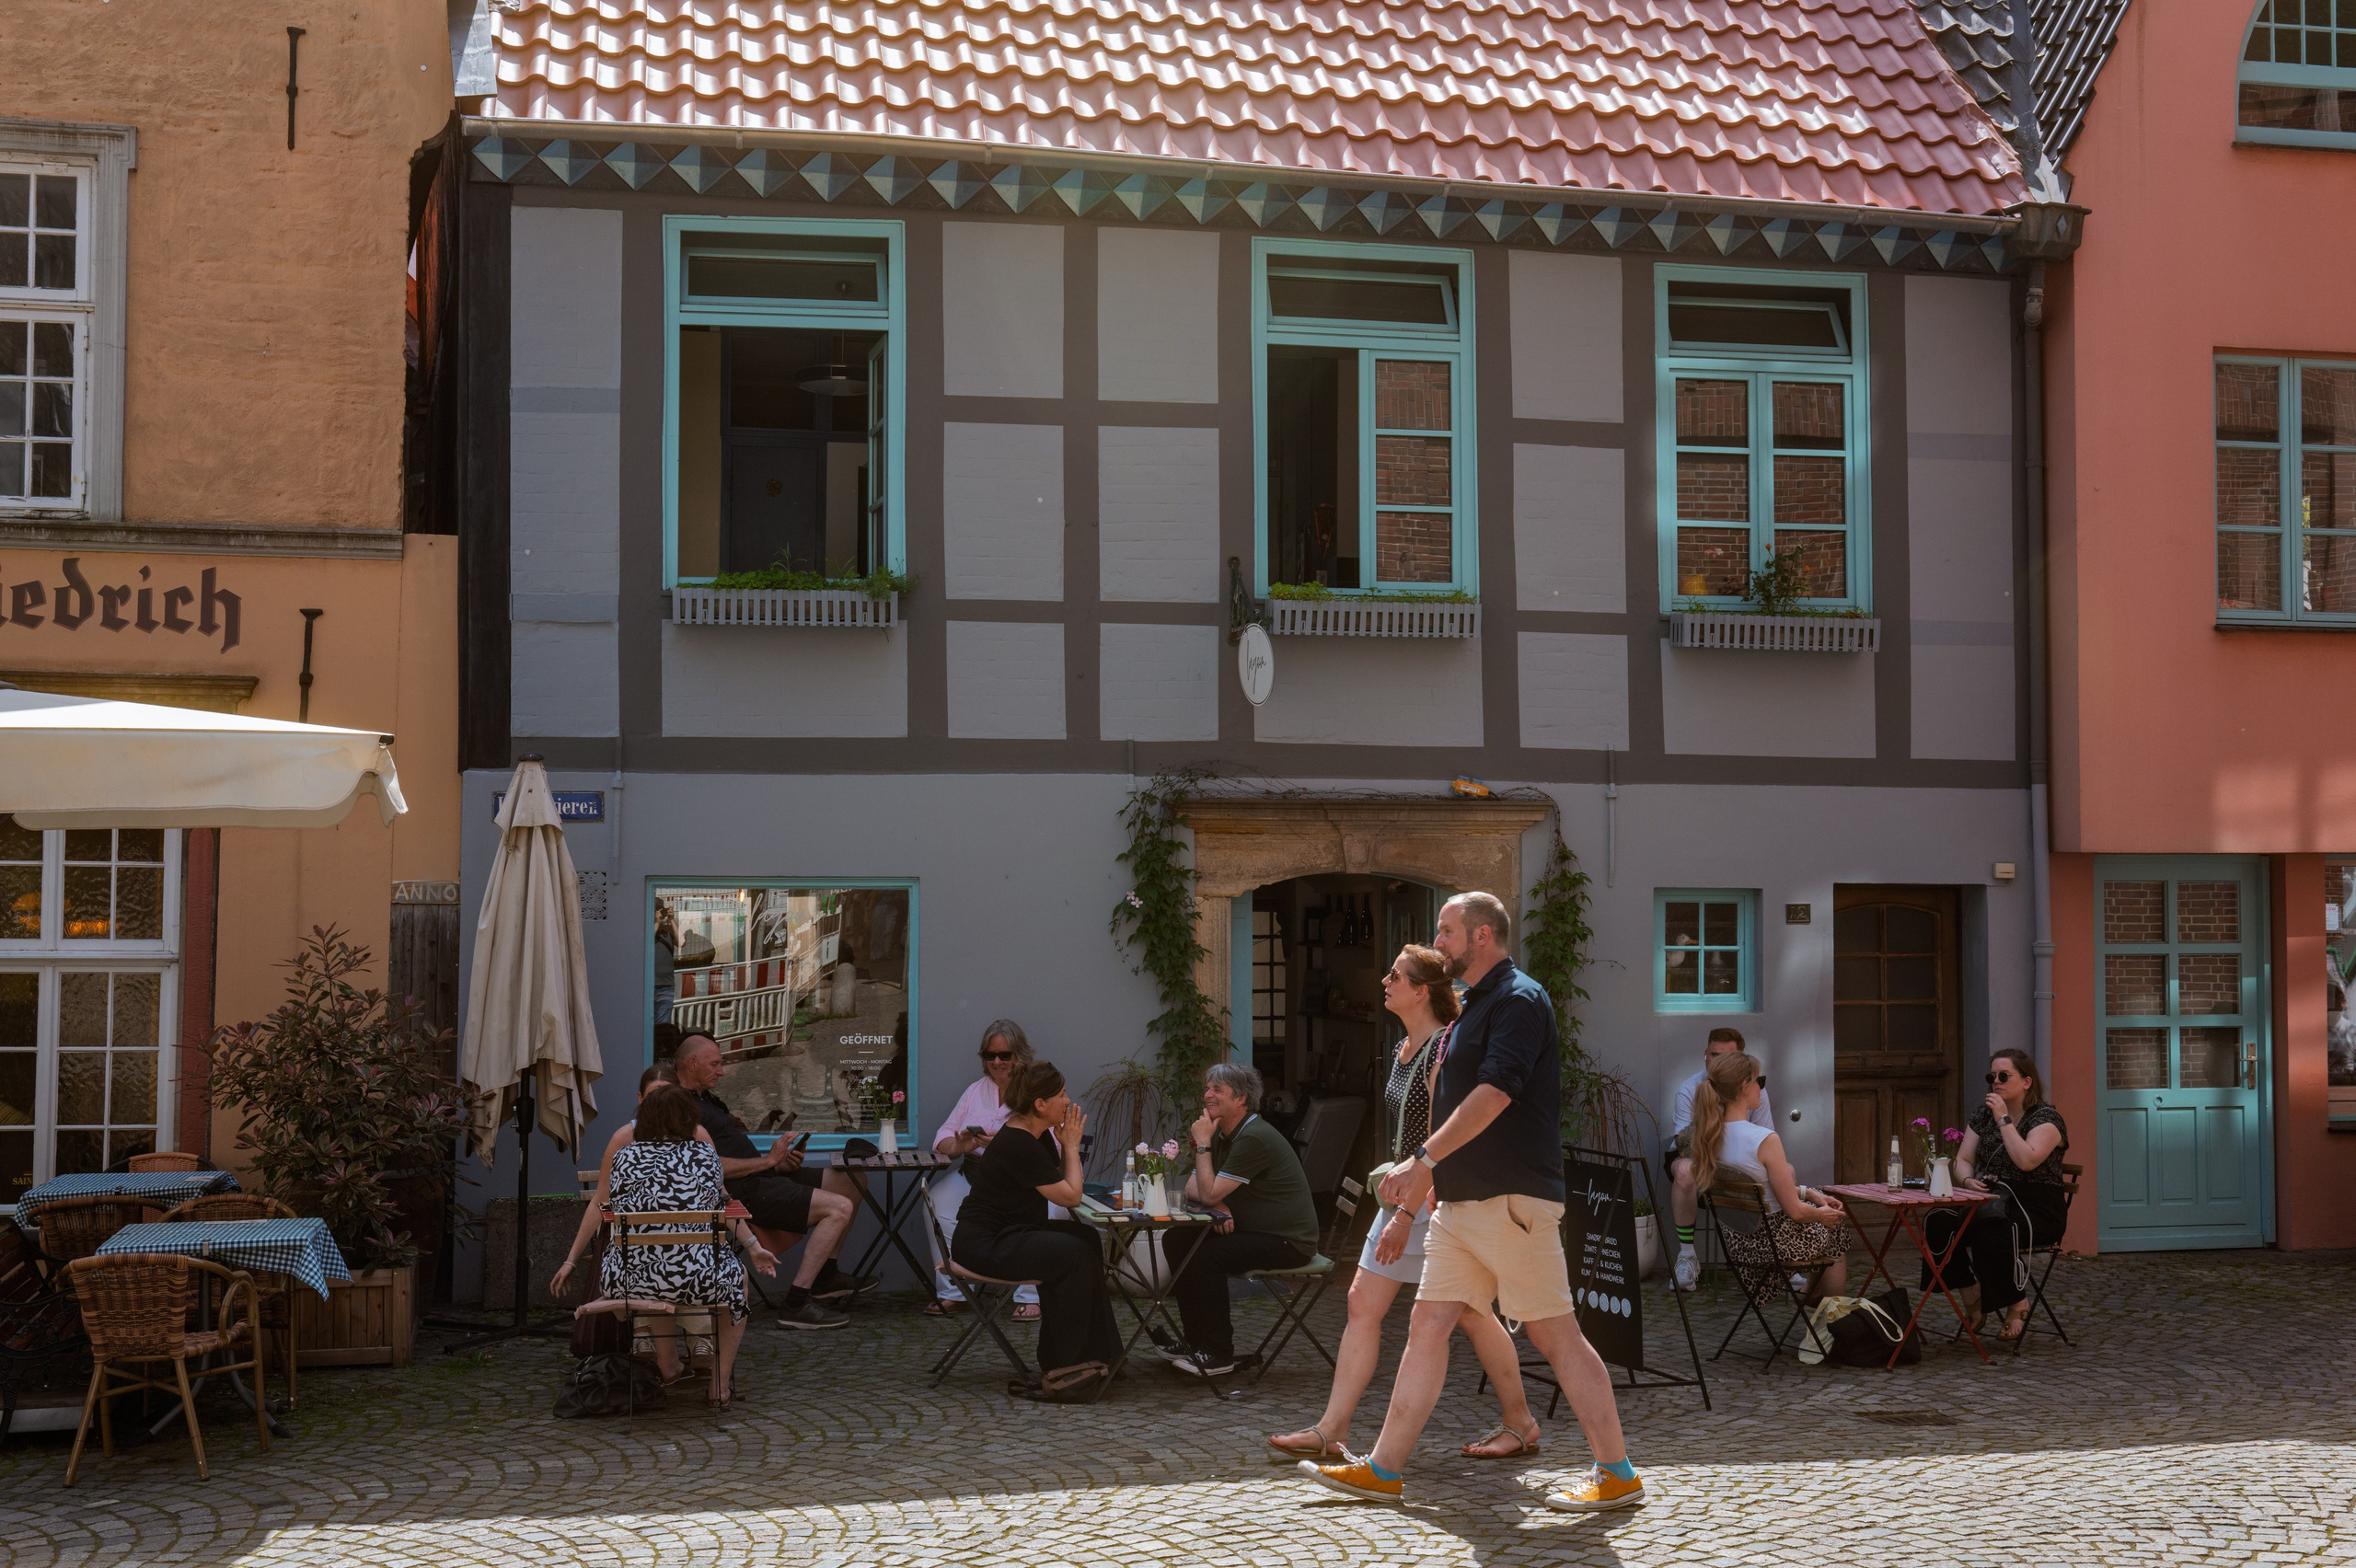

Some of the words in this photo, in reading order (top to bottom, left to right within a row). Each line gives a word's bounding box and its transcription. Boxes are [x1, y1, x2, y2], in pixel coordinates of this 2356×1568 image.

[555, 797, 598, 814] ieren
[395, 882, 457, 902] ANNO
[839, 1032, 893, 1045] GEÖFFNET
[1600, 1272, 1625, 1286] HANDWERK
